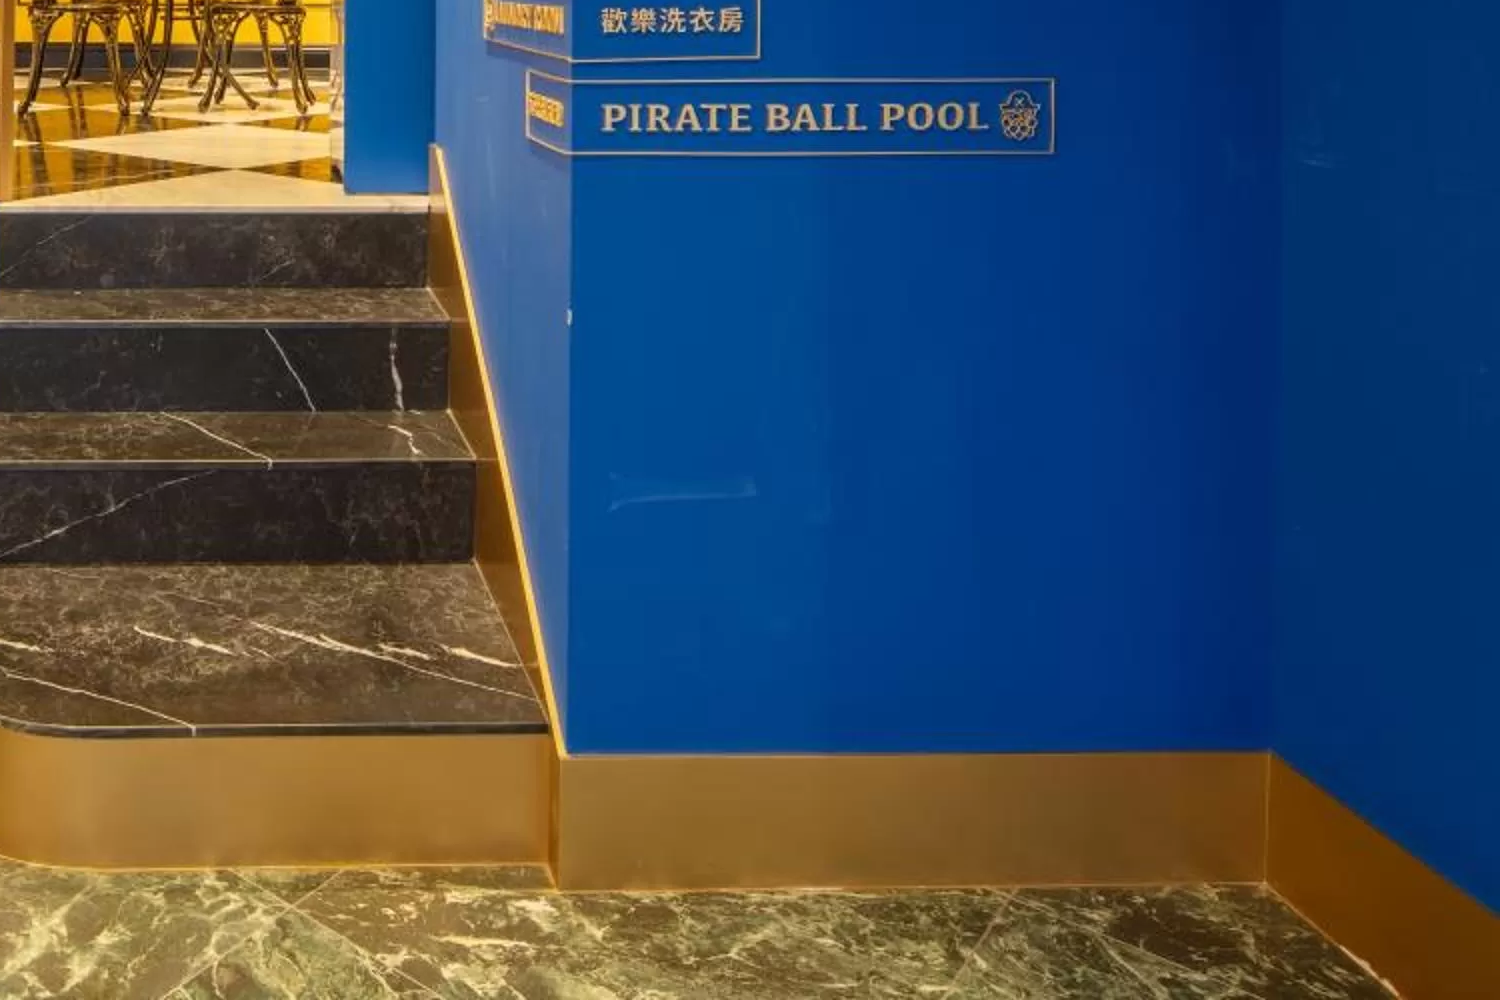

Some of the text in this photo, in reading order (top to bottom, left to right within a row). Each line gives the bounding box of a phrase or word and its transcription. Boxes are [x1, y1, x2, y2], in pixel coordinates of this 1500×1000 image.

[601, 6, 745, 34] 歡樂洗衣房
[601, 102, 989, 133] PIRATE BALL POOL
